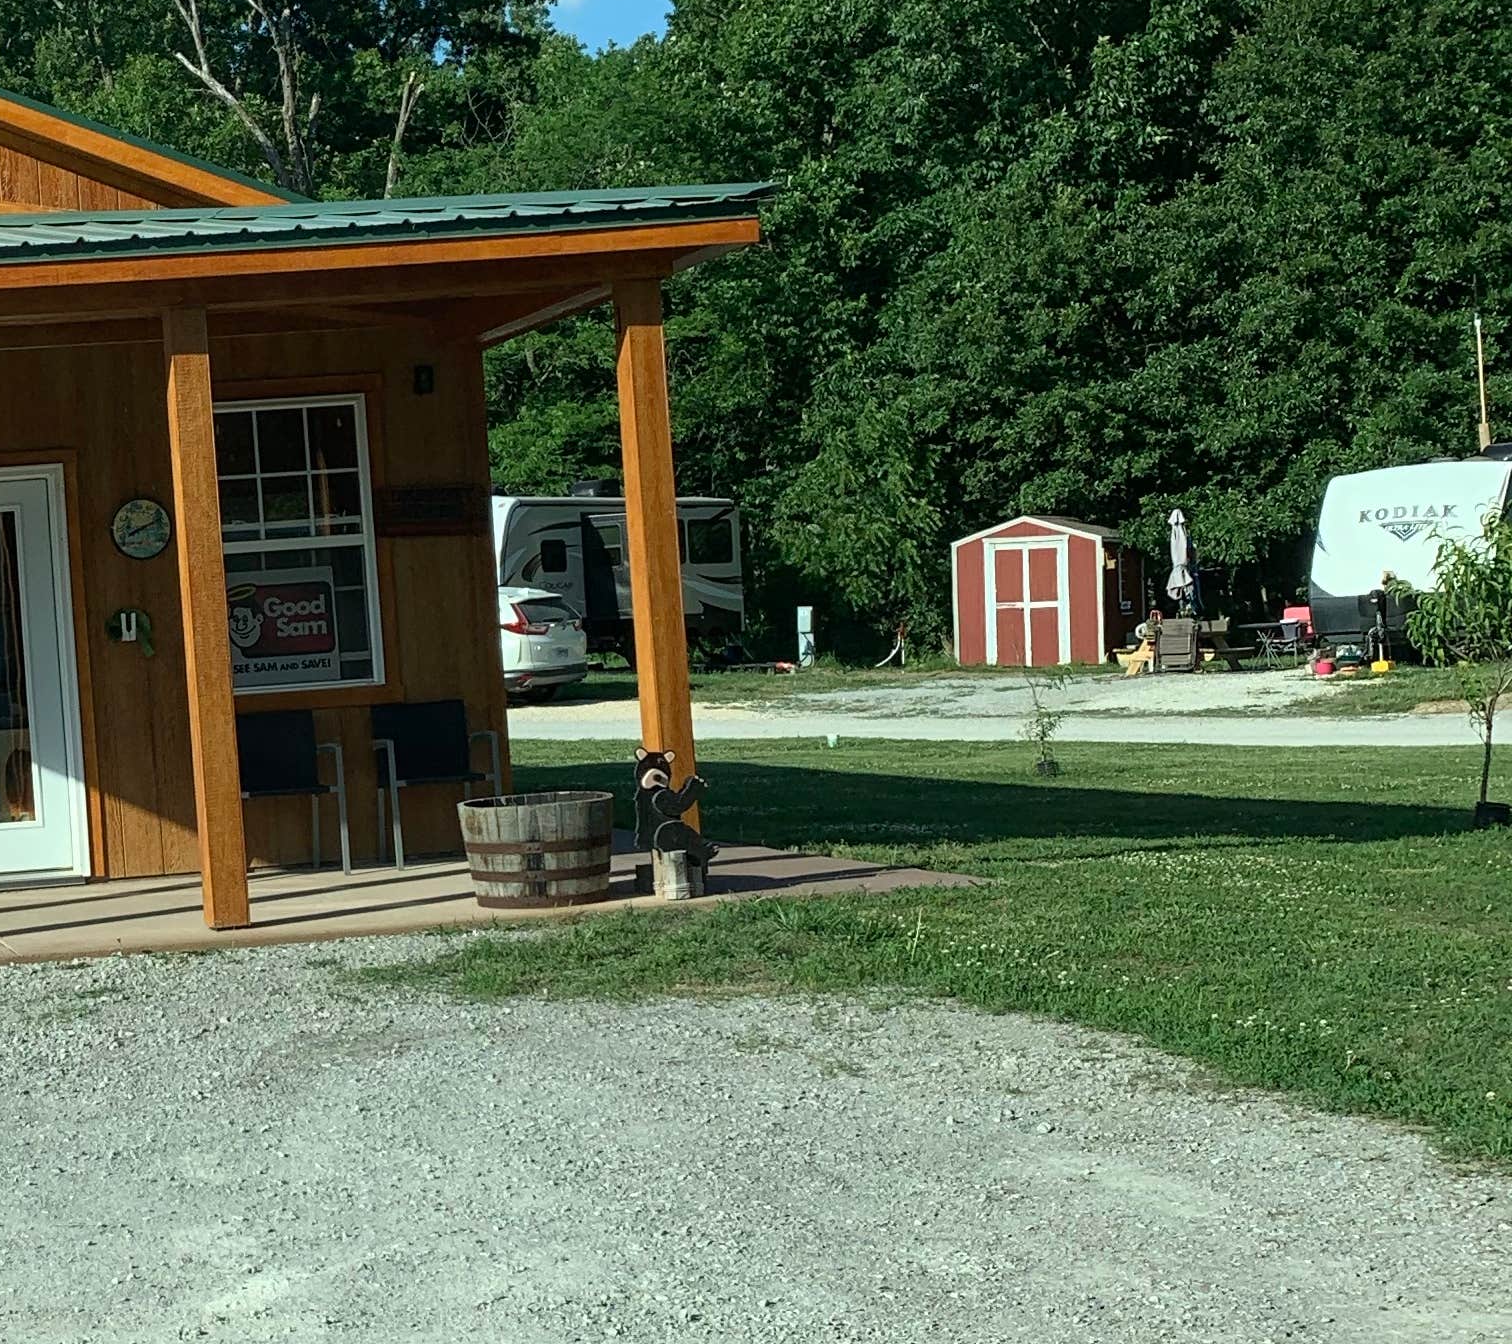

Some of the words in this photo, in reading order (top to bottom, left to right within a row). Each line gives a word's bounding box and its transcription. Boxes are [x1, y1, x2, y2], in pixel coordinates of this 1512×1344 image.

[1358, 504, 1458, 524] KODIAK
[263, 593, 326, 617] Good
[276, 617, 328, 638] Sam
[233, 664, 250, 674] SEE
[253, 662, 278, 672] SAM
[280, 663, 298, 671] AND
[301, 659, 331, 669] SAVE!
